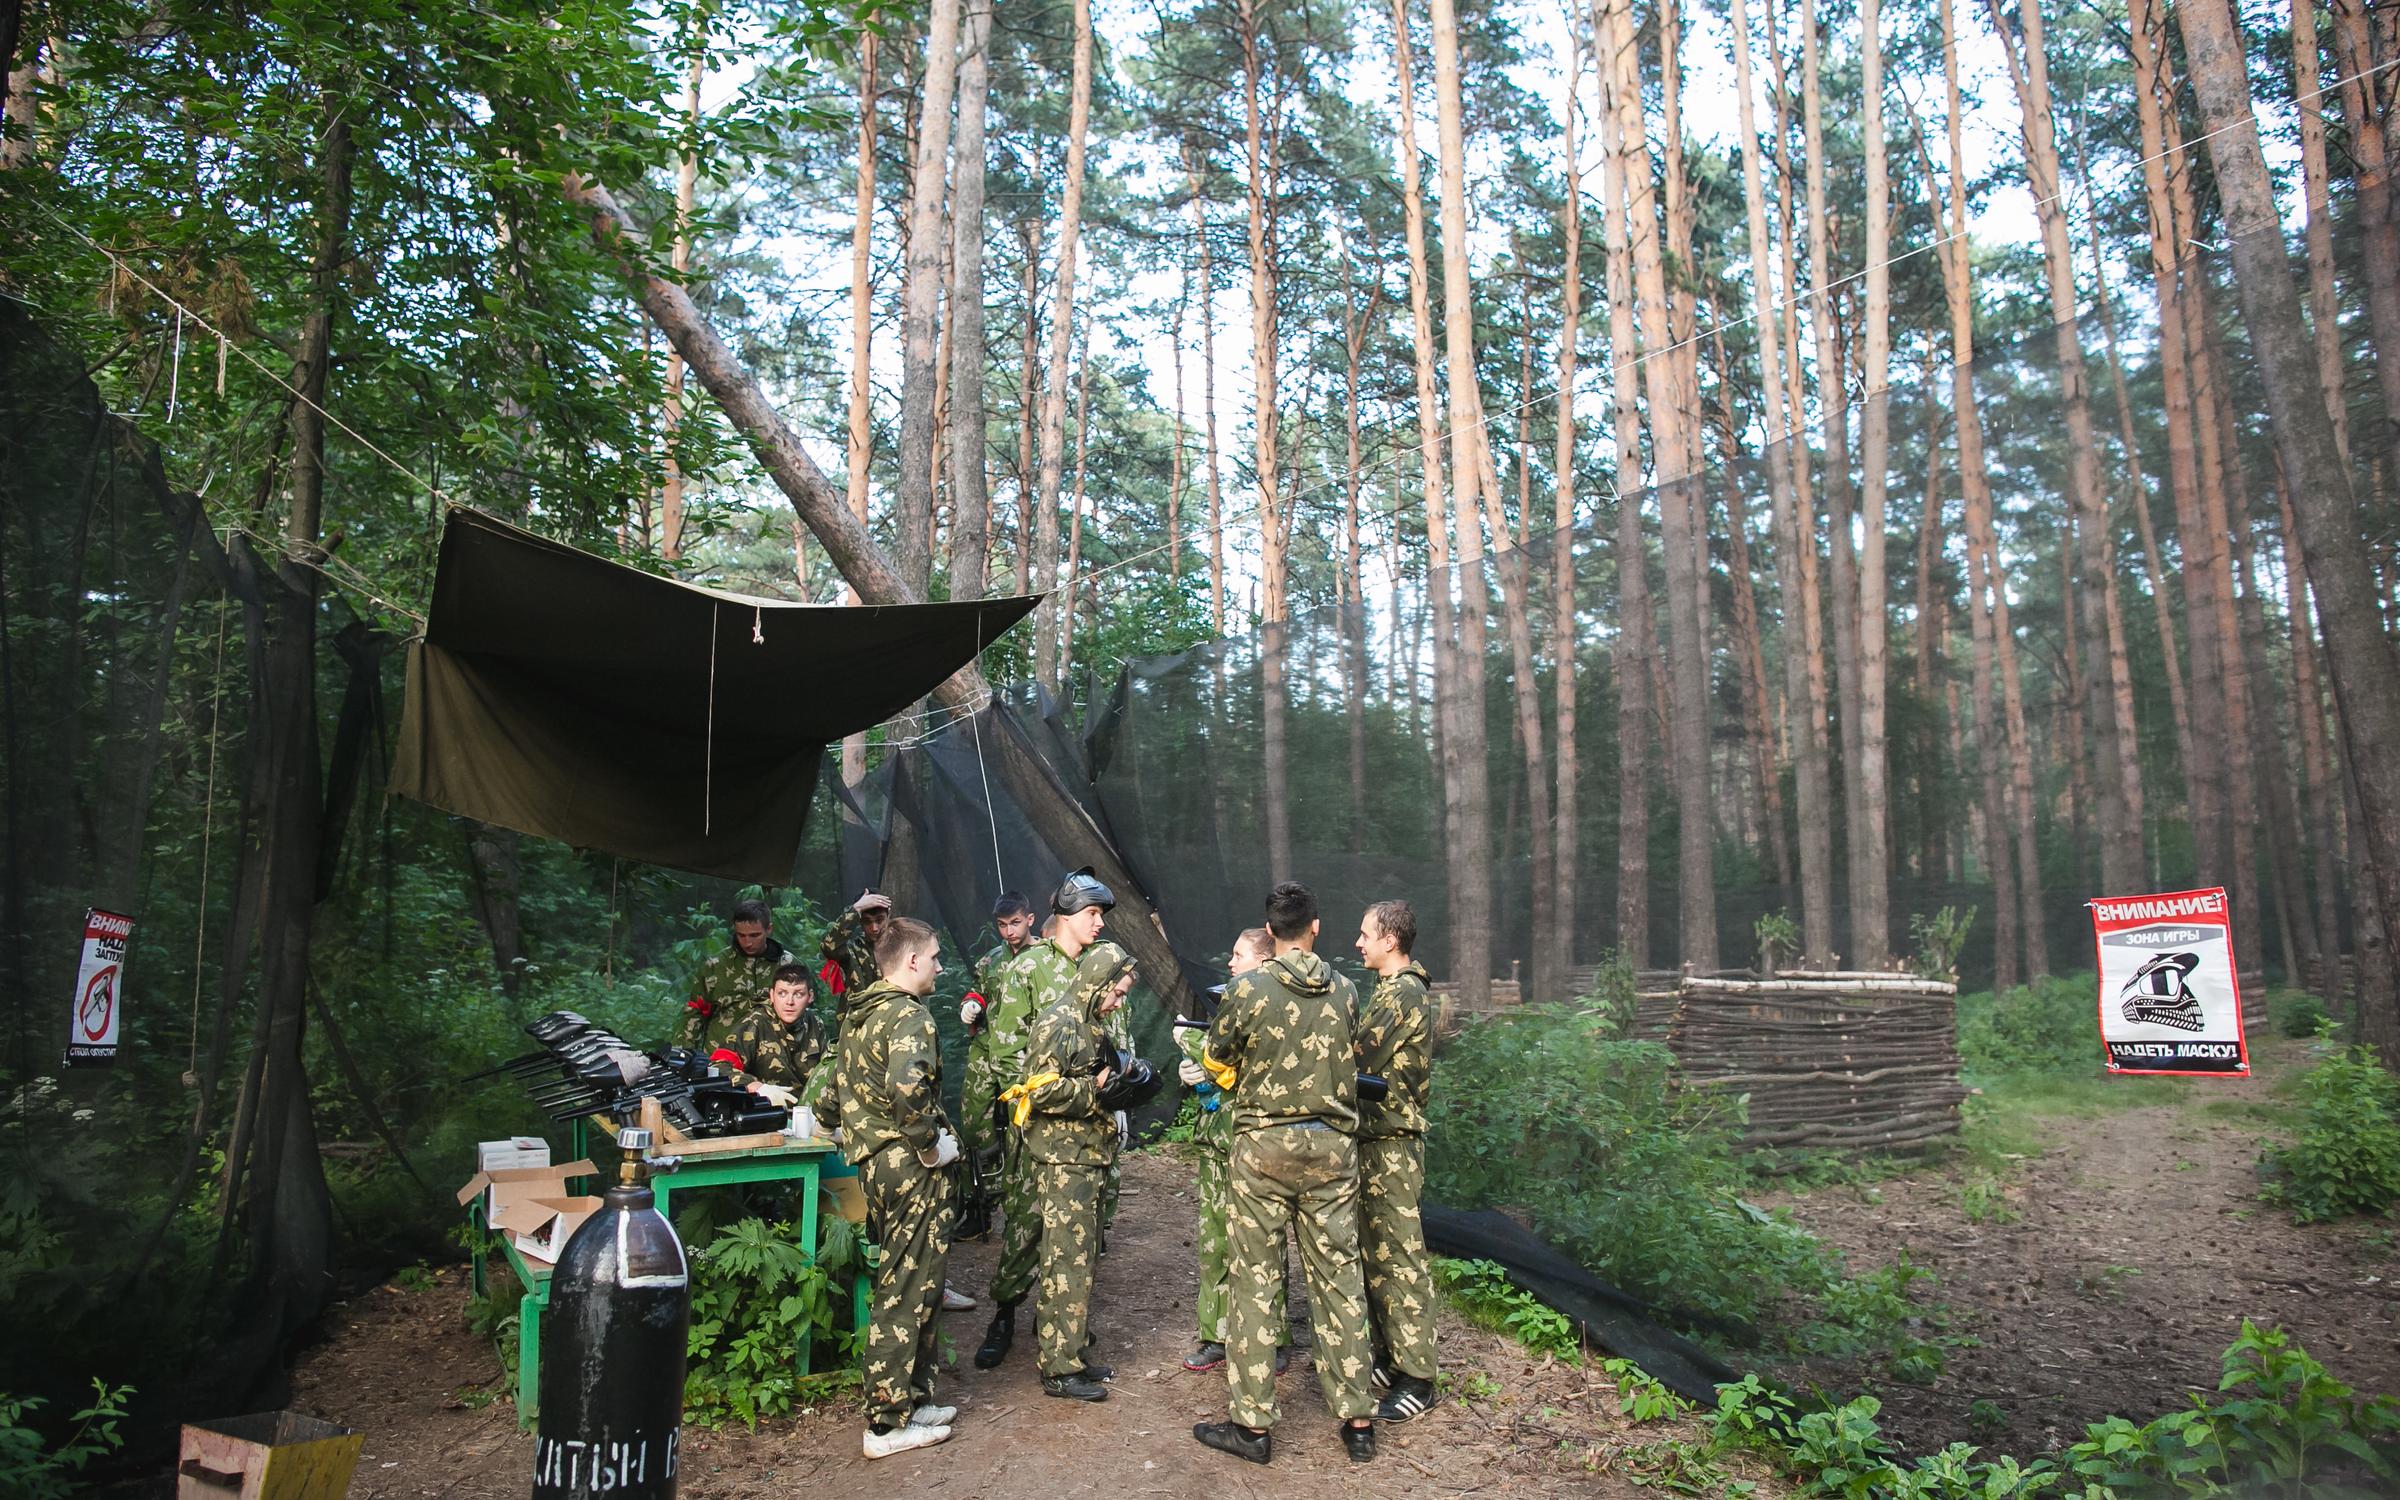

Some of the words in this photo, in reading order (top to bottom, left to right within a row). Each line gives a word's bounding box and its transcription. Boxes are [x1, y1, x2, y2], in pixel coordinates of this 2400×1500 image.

[2097, 895, 2222, 921] ВНИМАНИЕ!
[2126, 932, 2160, 944] ЗОНА
[2163, 929, 2200, 942] ИГРЫ
[2111, 1044, 2174, 1057] НАДЕТЬ
[2177, 1044, 2238, 1058] МАСКУ!
